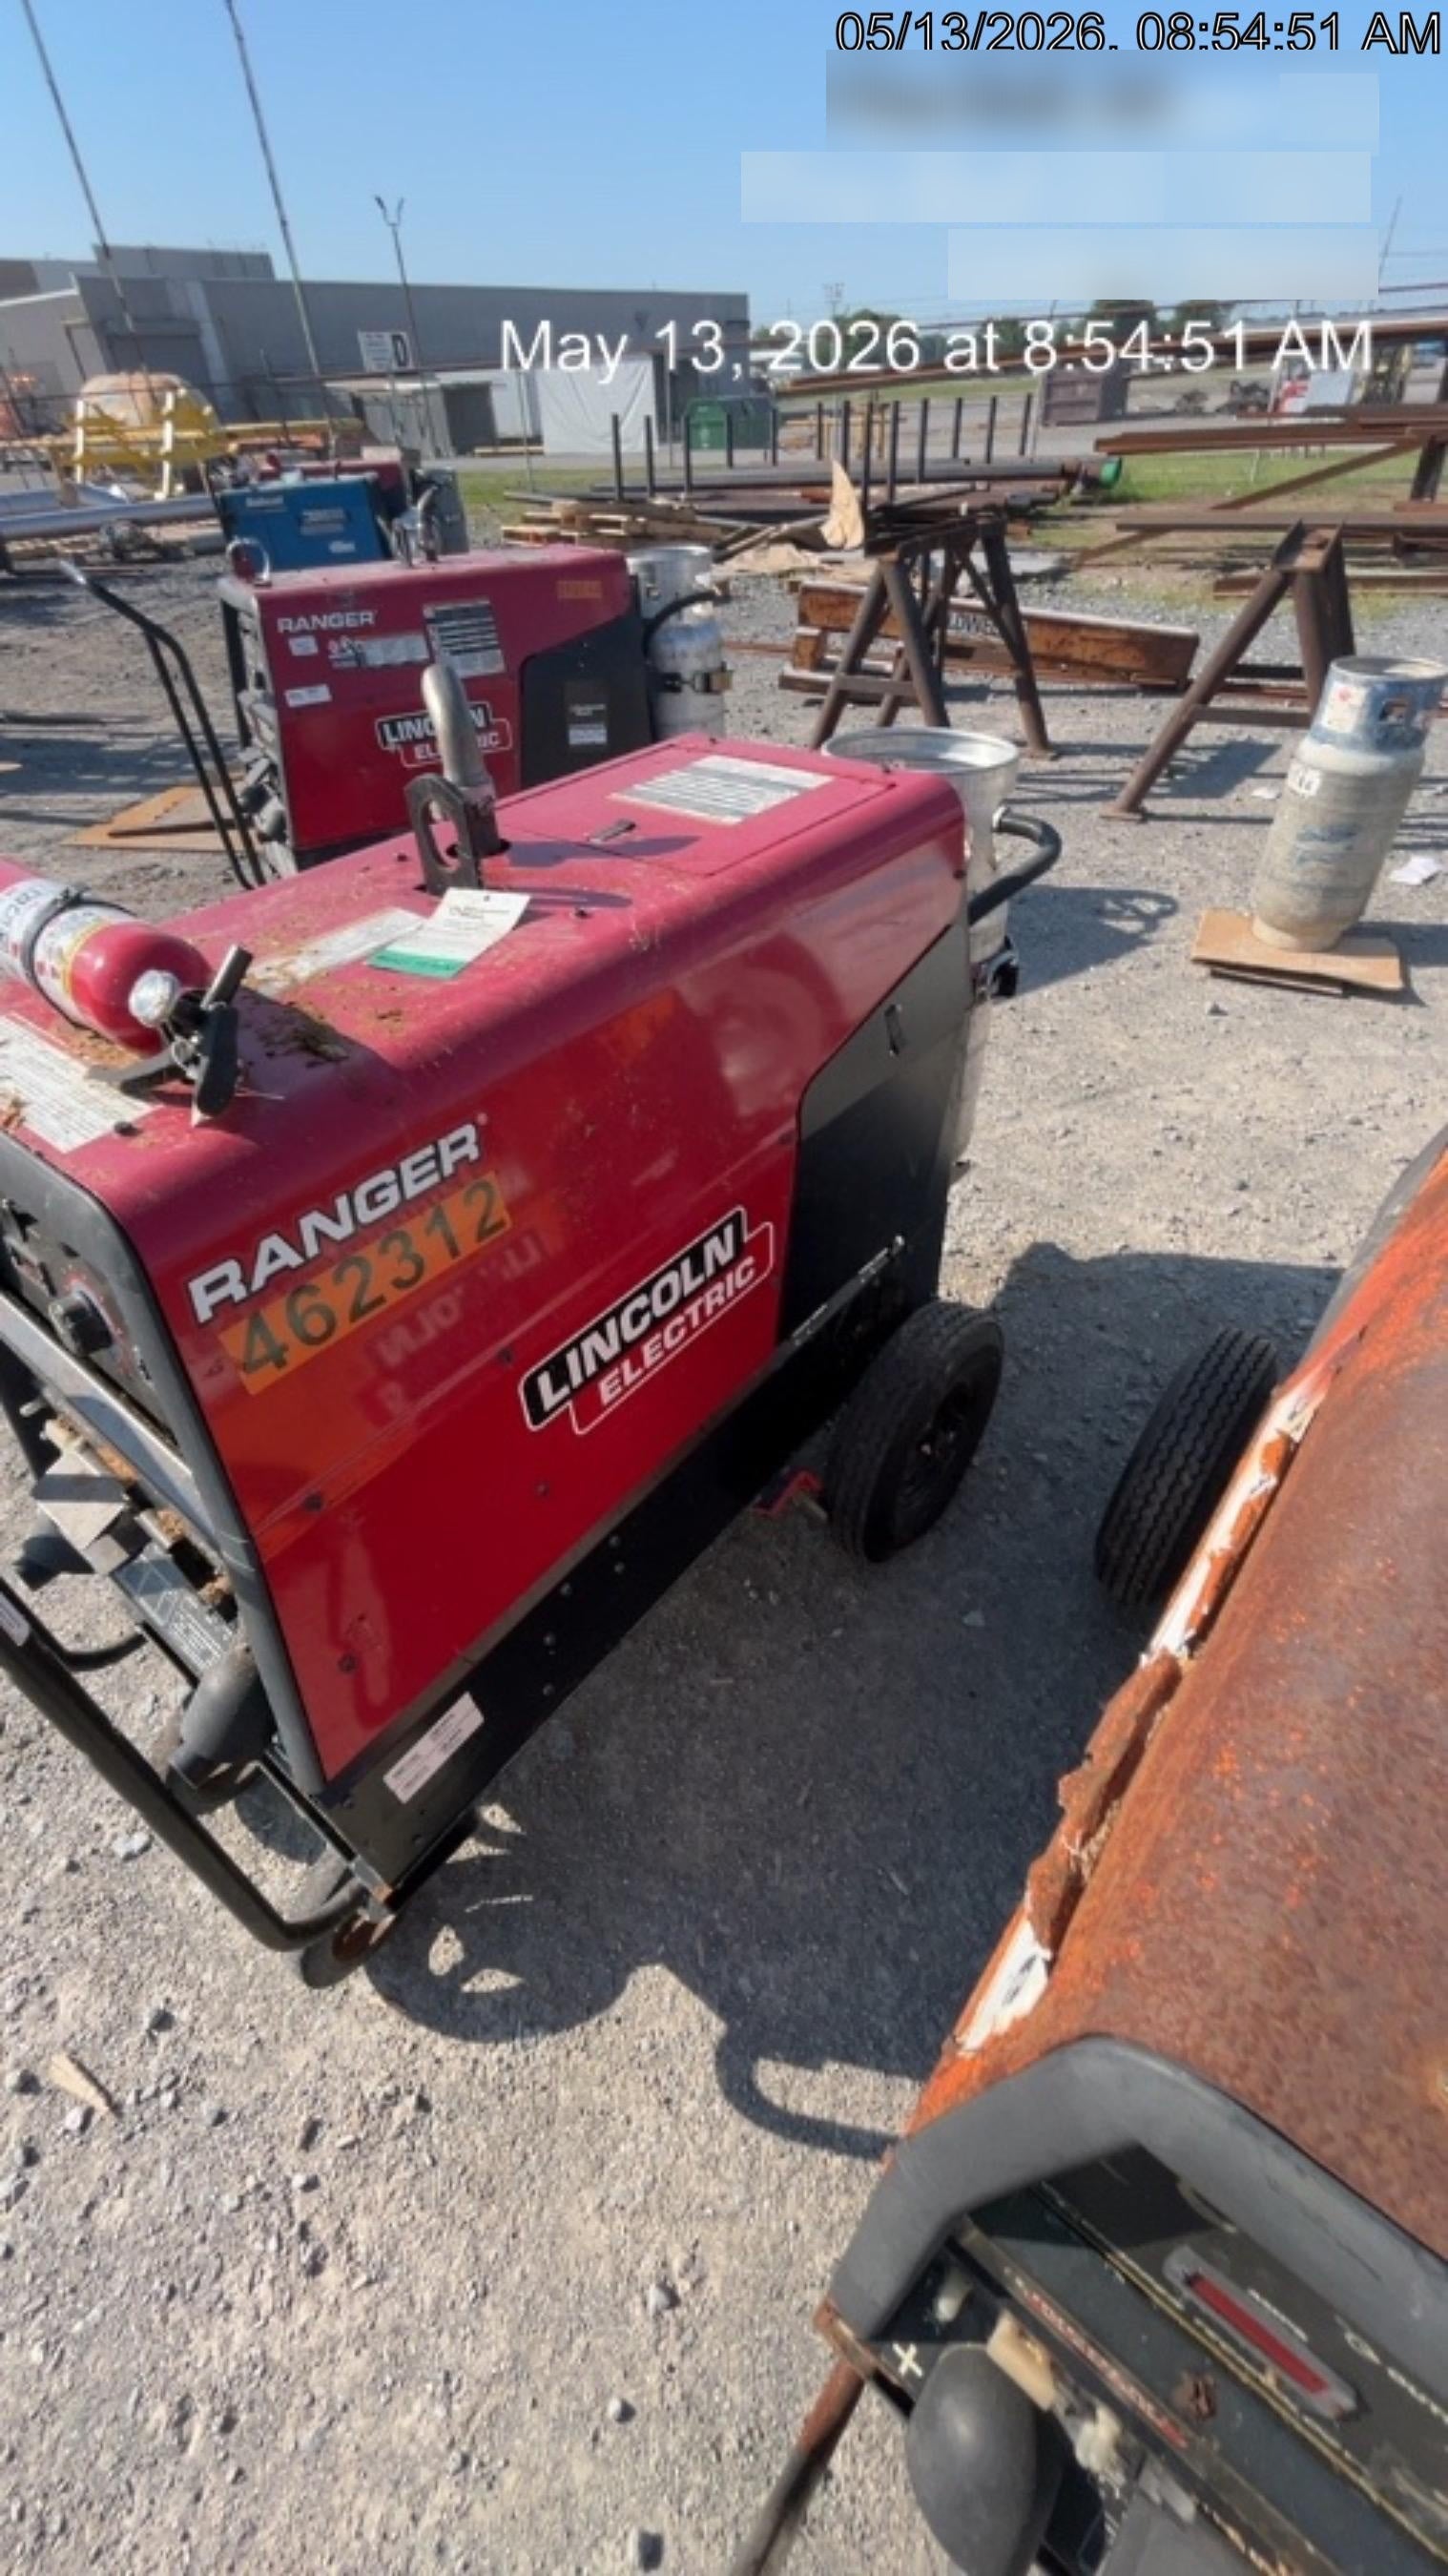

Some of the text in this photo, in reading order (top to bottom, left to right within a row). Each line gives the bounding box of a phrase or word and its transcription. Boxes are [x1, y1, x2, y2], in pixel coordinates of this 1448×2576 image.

[278, 612, 375, 634] RANGER
[383, 707, 485, 742] LINCN
[189, 1124, 480, 1322] RANGER
[241, 1179, 506, 1374] 462312
[537, 1224, 734, 1412] LINCOLN
[598, 1257, 755, 1404] ELECTRIC
